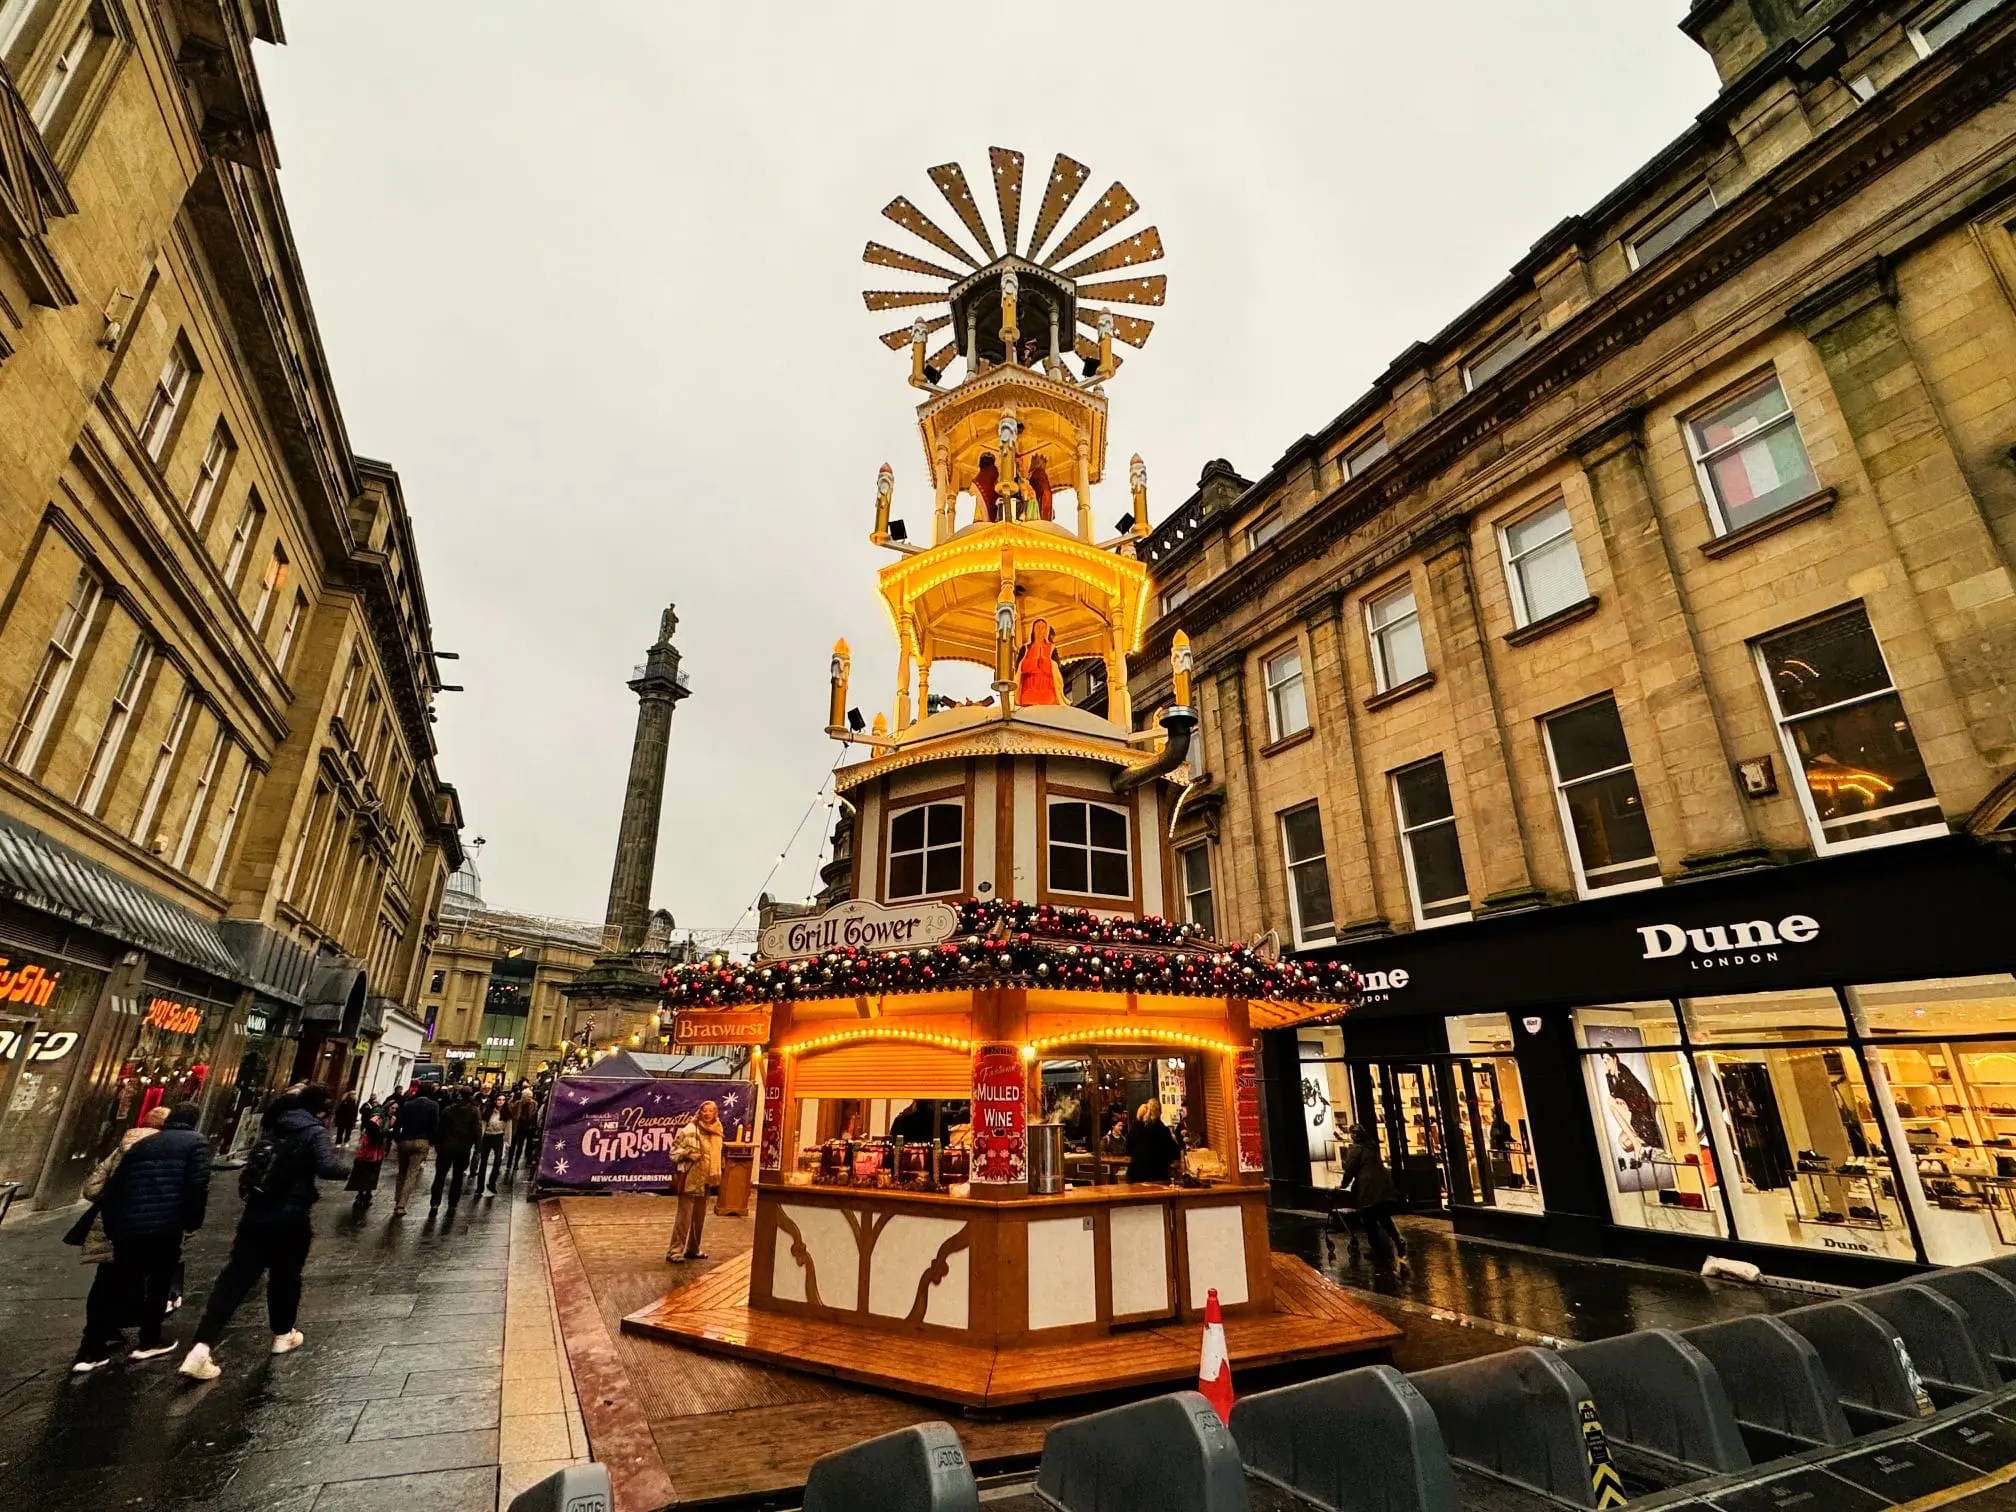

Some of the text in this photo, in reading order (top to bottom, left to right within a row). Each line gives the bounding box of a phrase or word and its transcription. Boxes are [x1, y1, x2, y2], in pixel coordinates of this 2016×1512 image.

[788, 915, 922, 952] Grill Tower
[1636, 914, 1820, 959] Dune
[1691, 952, 1778, 969] LONDON
[679, 1020, 765, 1038] Bratwurst
[486, 1037, 515, 1046] REISS
[446, 1049, 476, 1060] banyan
[977, 1083, 1020, 1102] MULLED
[984, 1108, 1014, 1127] WINE
[1821, 1237, 1868, 1252] Dune
